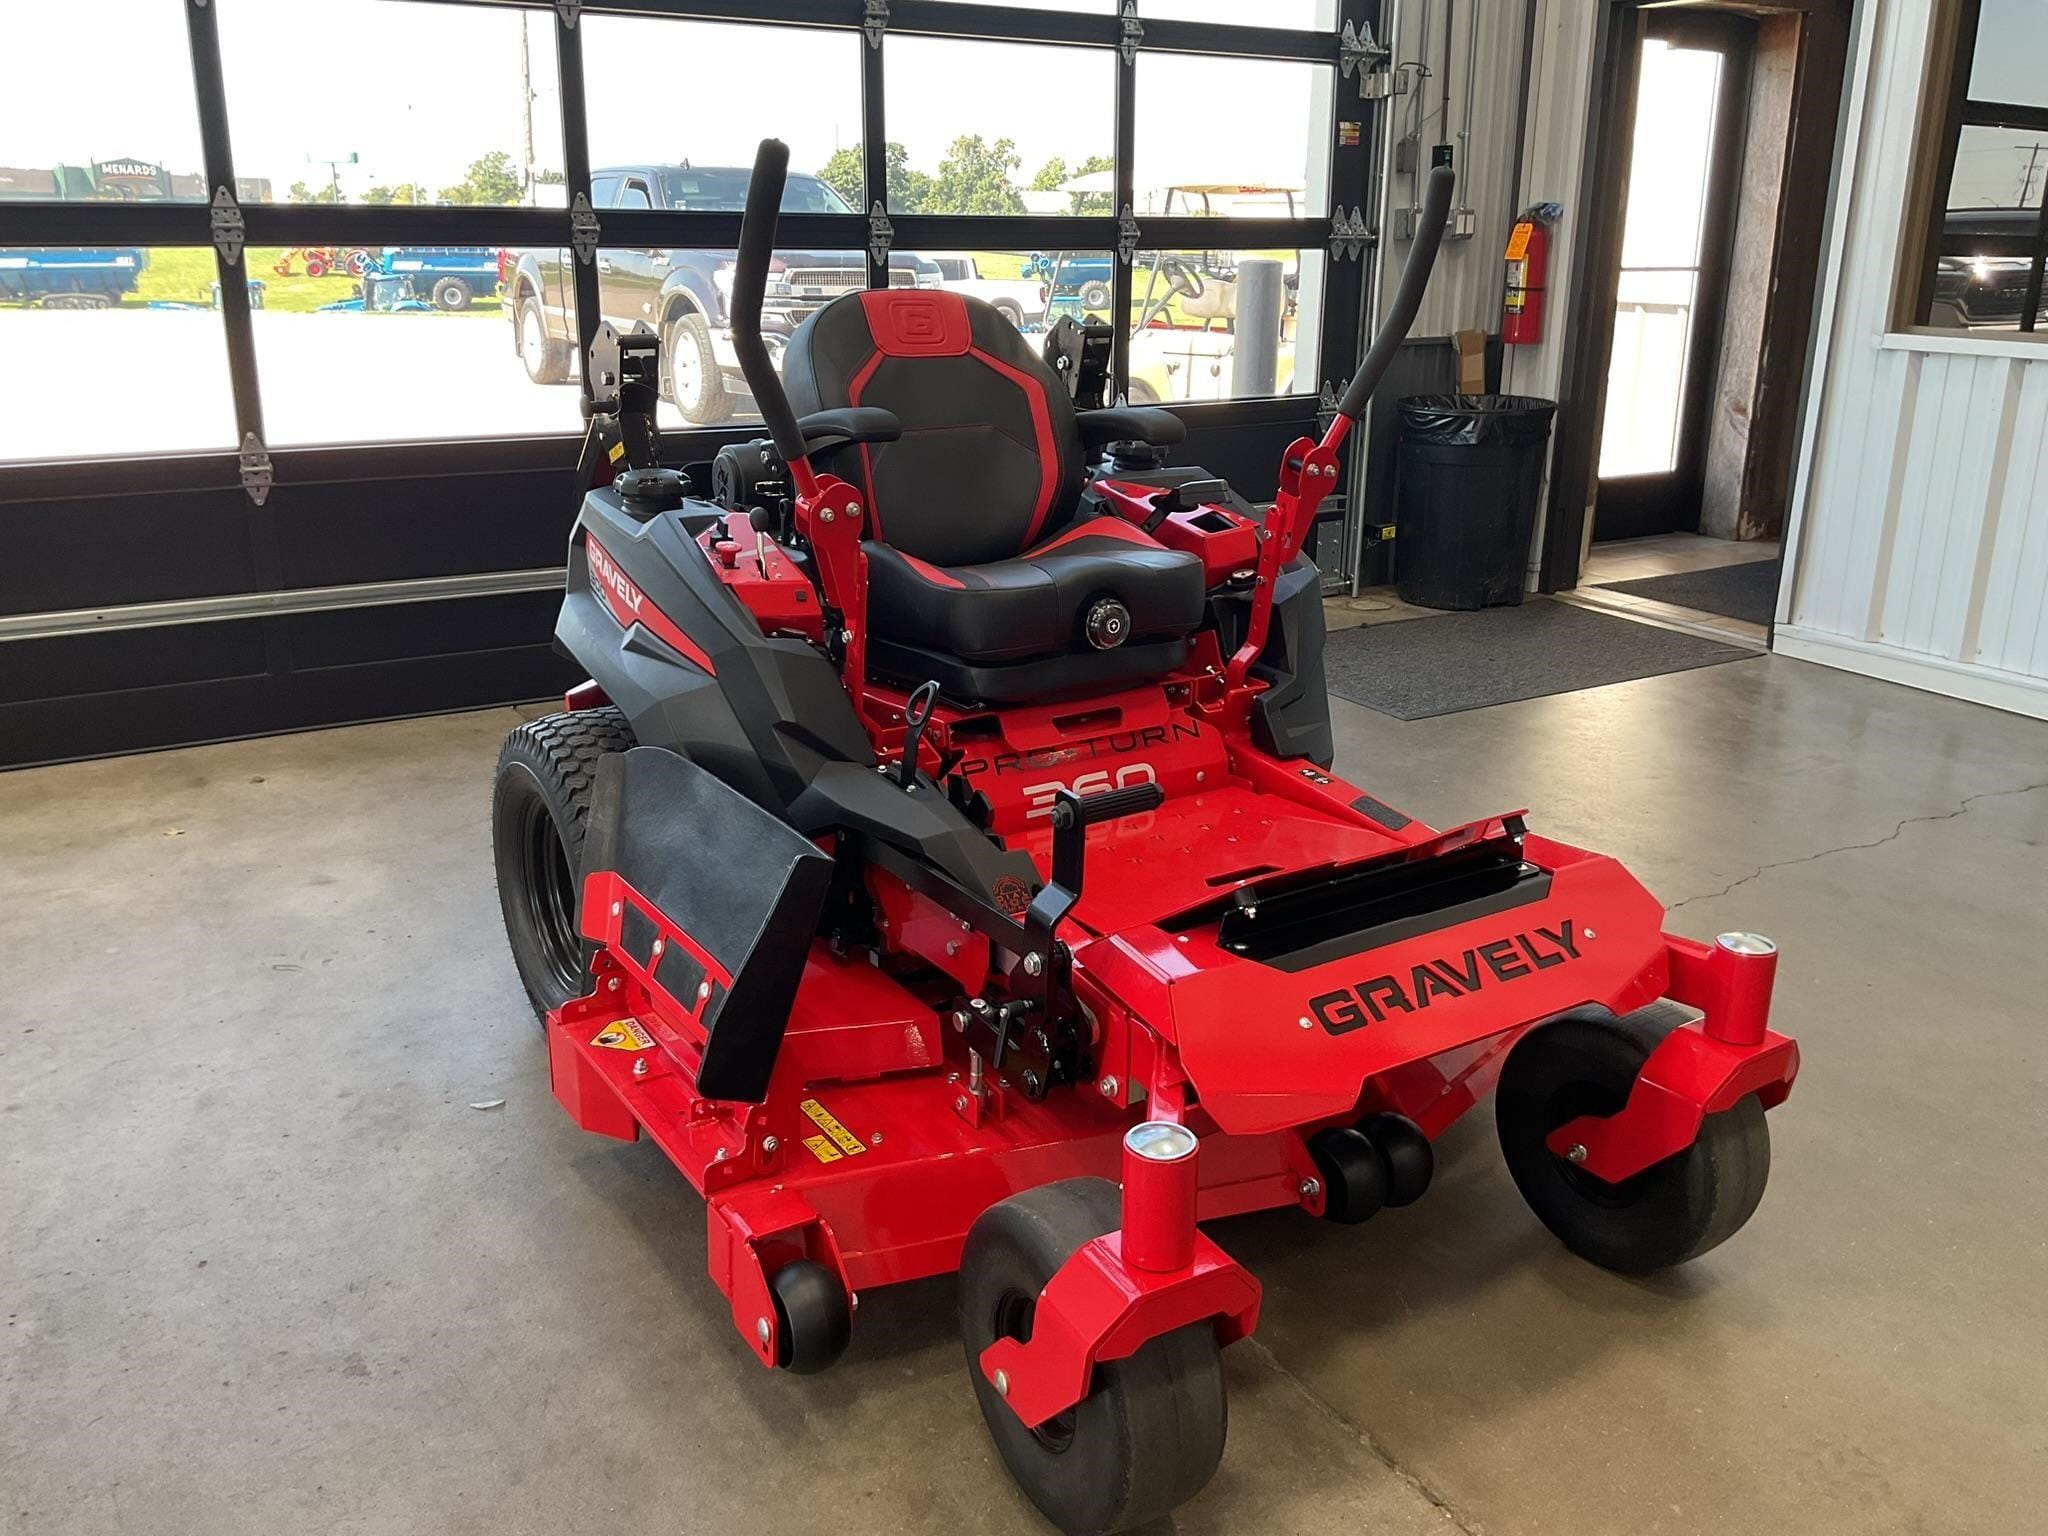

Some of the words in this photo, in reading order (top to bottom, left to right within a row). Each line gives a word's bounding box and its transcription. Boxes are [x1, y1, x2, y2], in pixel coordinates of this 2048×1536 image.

[101, 163, 157, 176] MENARDS
[589, 539, 643, 615] GRAVELY
[1023, 762, 1156, 819] 360
[1309, 919, 1582, 1036] GRAVELY
[624, 1020, 651, 1046] DANGER
